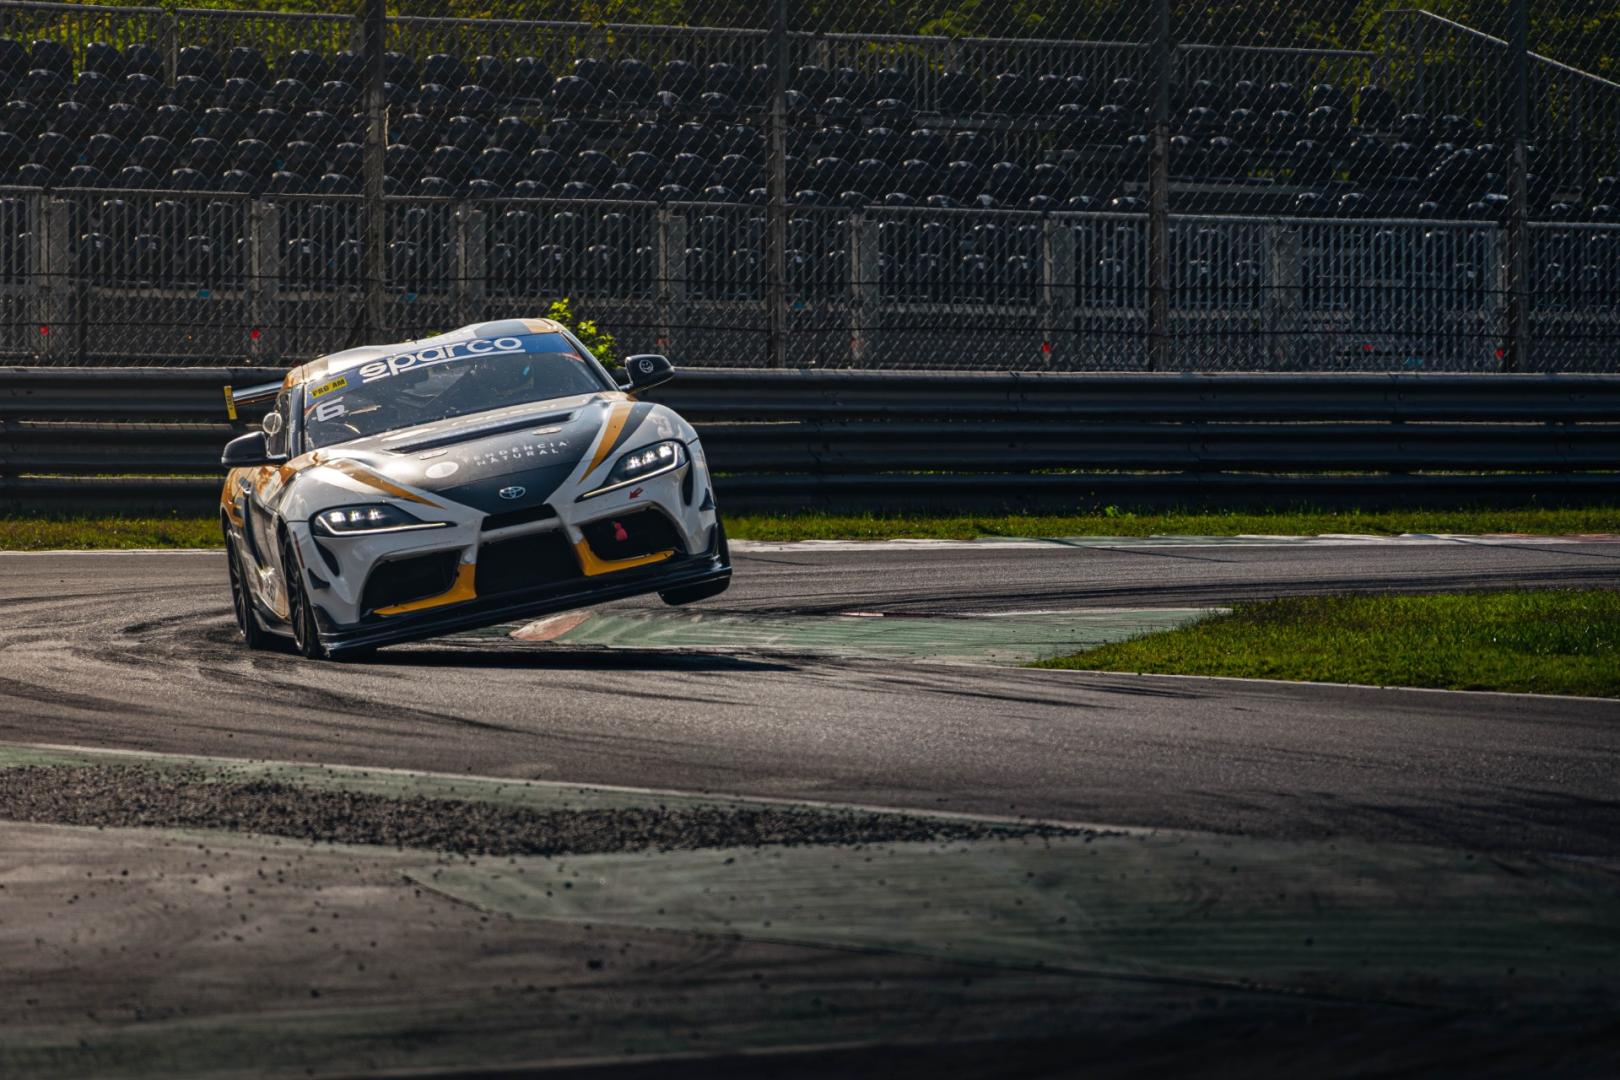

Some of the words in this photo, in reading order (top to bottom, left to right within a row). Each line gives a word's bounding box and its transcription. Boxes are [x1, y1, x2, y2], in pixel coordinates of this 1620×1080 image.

[359, 337, 522, 377] sparco
[312, 385, 330, 397] PRO
[332, 379, 346, 388] AM
[316, 396, 345, 422] 6
[477, 448, 559, 466] NATURAL
